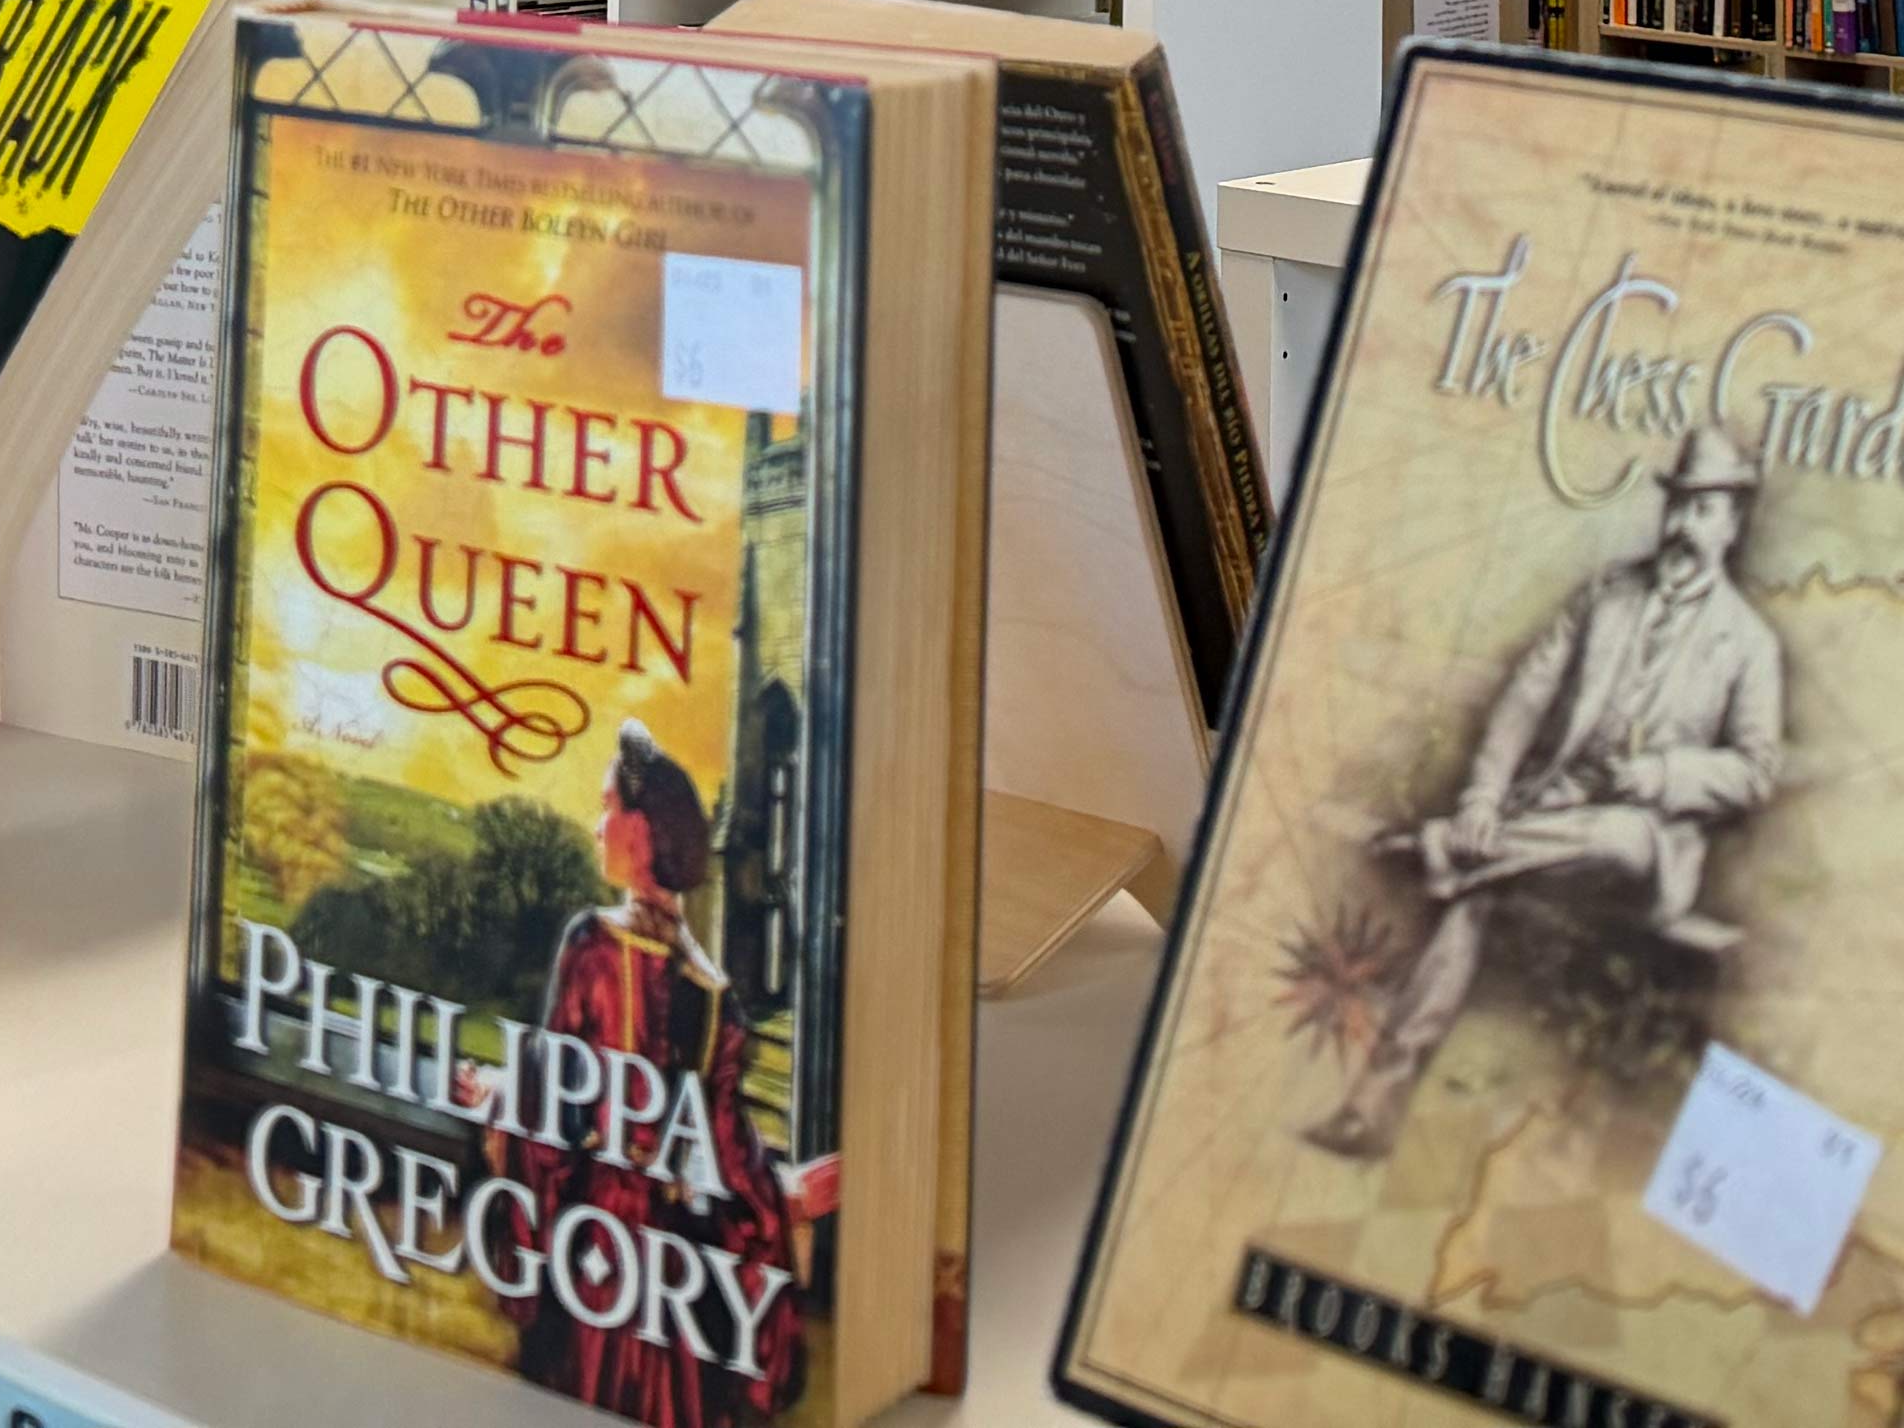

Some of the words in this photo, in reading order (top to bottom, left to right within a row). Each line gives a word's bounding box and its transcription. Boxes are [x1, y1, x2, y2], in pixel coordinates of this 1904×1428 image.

[314, 146, 346, 170] THE
[375, 156, 414, 181] NEW
[419, 162, 467, 188] YORK
[387, 186, 432, 217] THE
[438, 194, 513, 230] OTHER
[521, 206, 607, 243] BOLEYN
[611, 217, 667, 251] GIRL
[446, 292, 574, 357] The
[1438, 232, 1545, 408] The
[1536, 252, 1702, 510] Chess
[297, 323, 704, 528] OTHER
[96, 524, 129, 542] Cooper
[292, 480, 702, 734] QUEEN
[234, 916, 733, 1212] PHILIPPA
[245, 1100, 792, 1386] GREGORY
[1243, 1252, 1451, 1383] BROOKS
